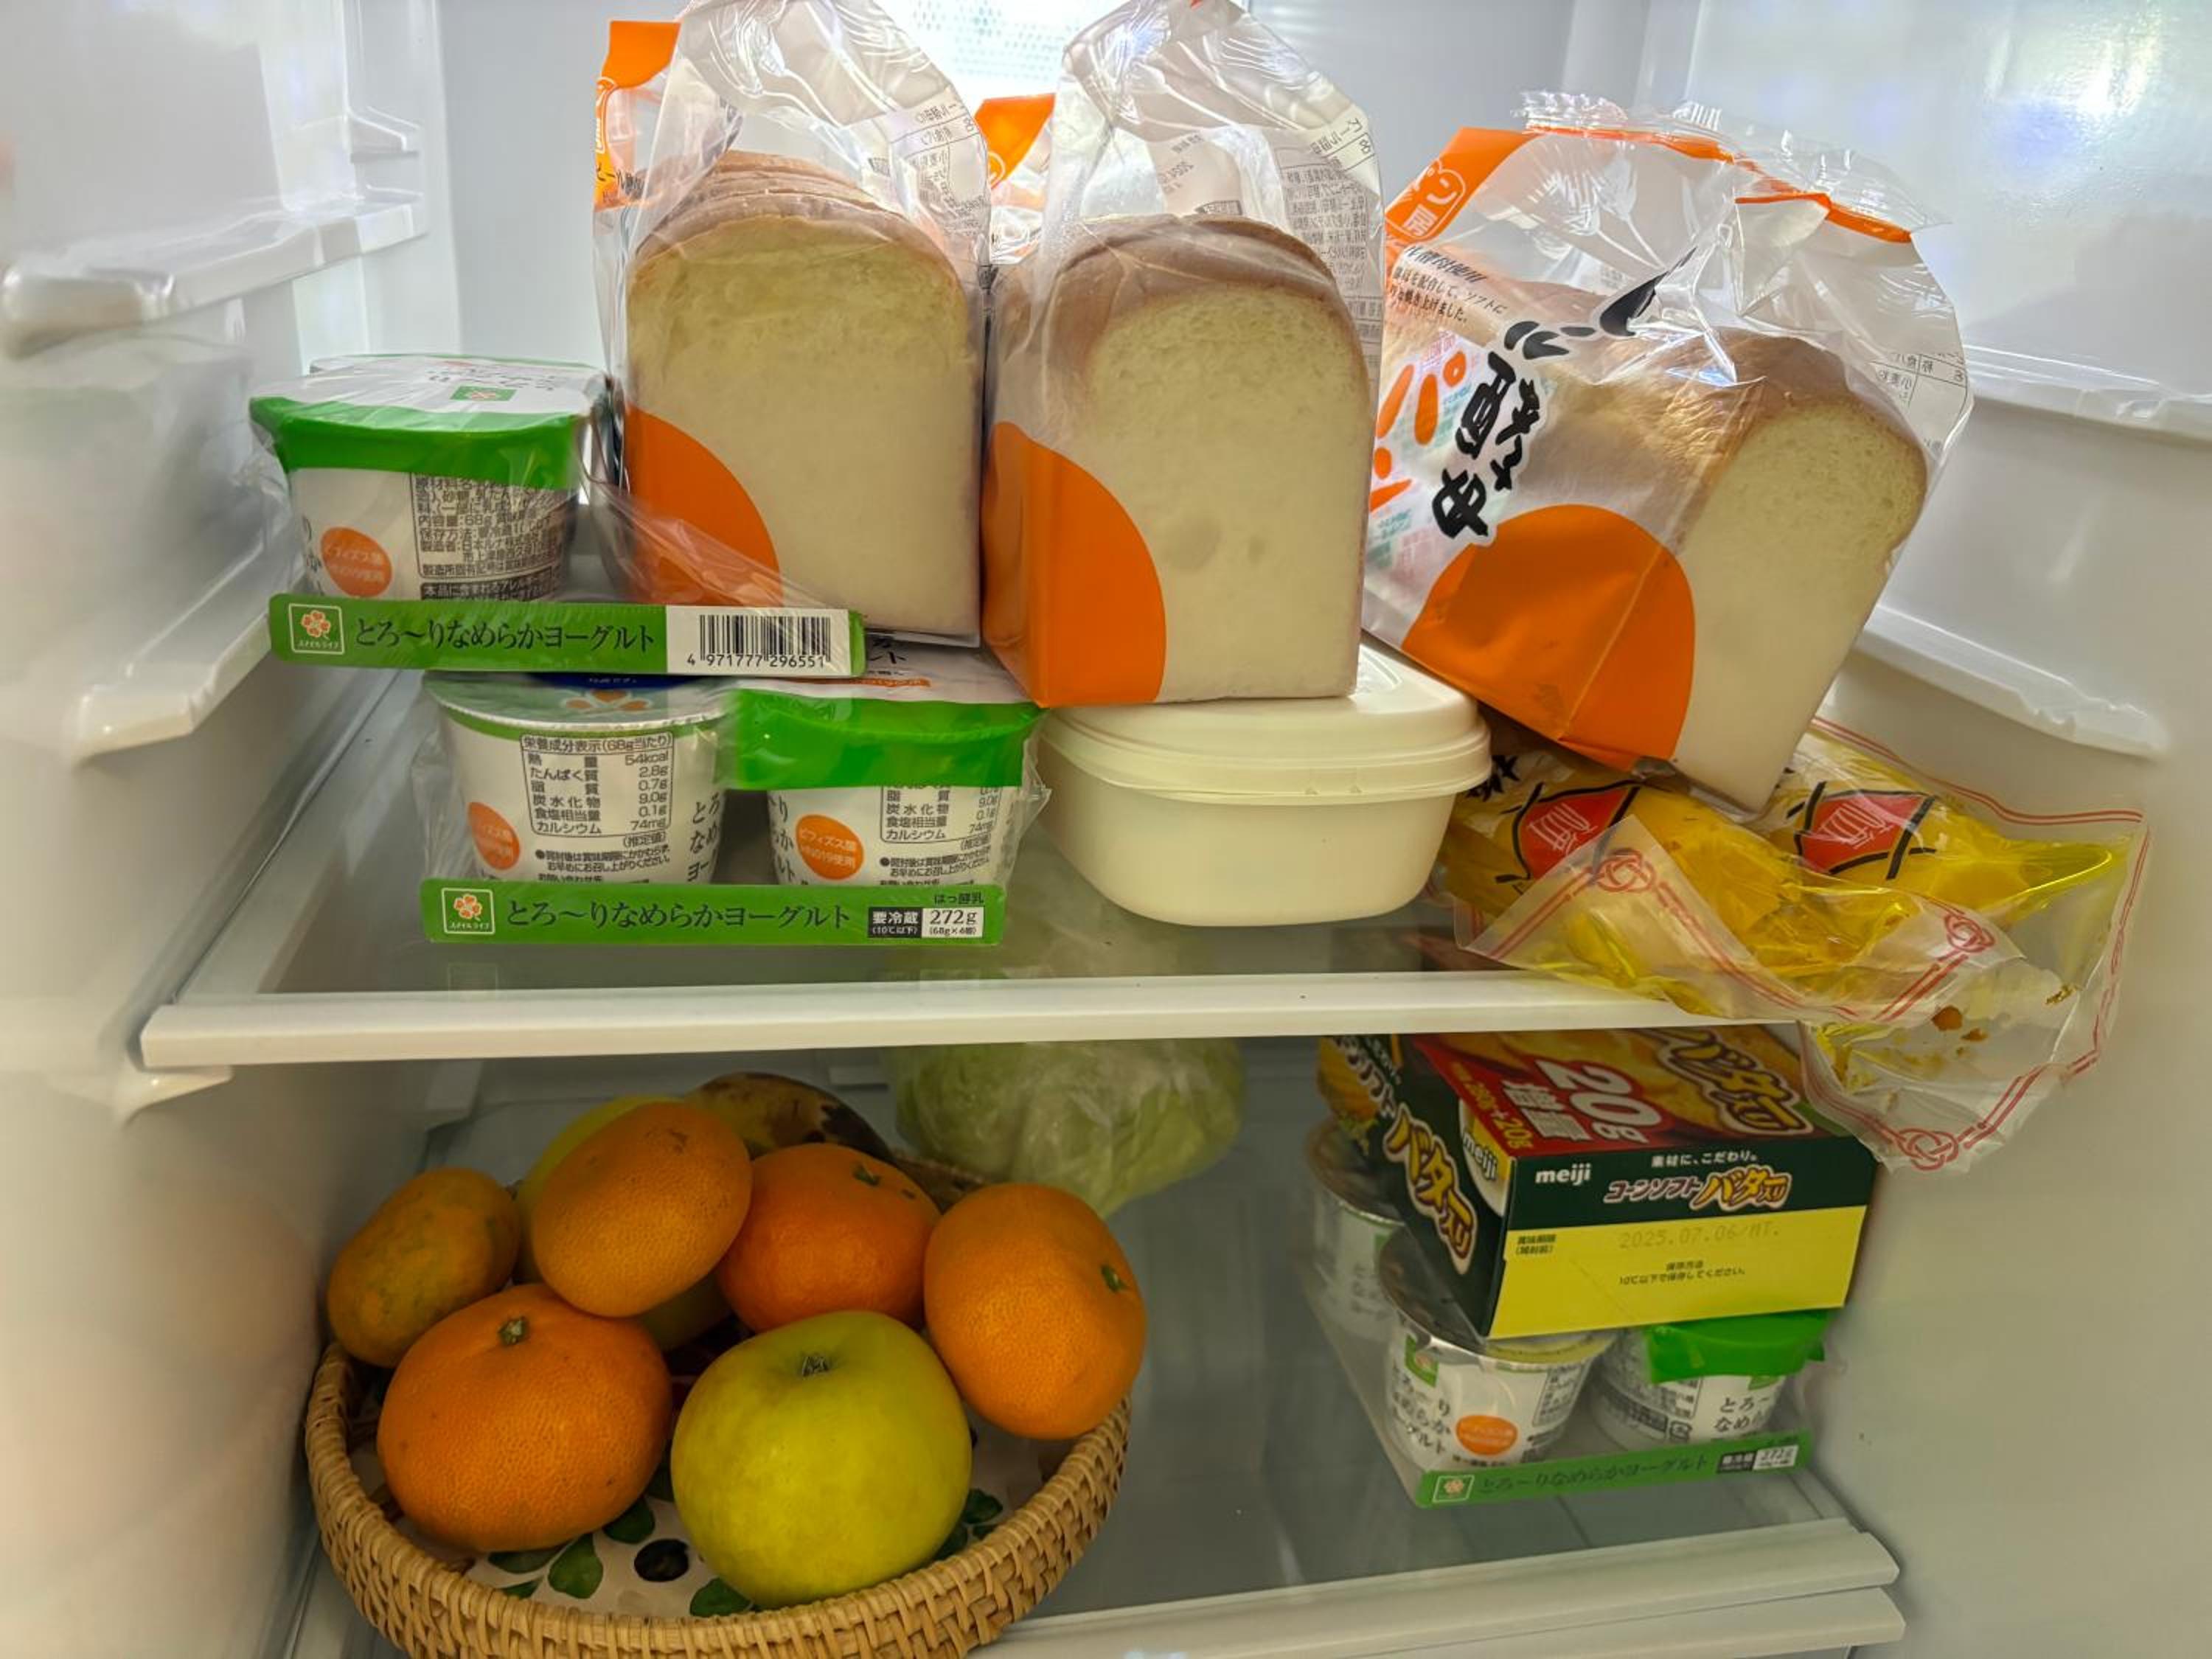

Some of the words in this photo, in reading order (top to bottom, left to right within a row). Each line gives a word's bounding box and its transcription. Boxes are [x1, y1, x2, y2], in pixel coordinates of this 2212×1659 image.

[686, 655, 695, 666] 4
[706, 654, 763, 668] 971777
[769, 654, 825, 668] 296551
[536, 821, 602, 834] カルシウム
[886, 828, 946, 841] カルシウム
[929, 909, 978, 925] 272g
[1535, 1162, 1591, 1186] meiji
